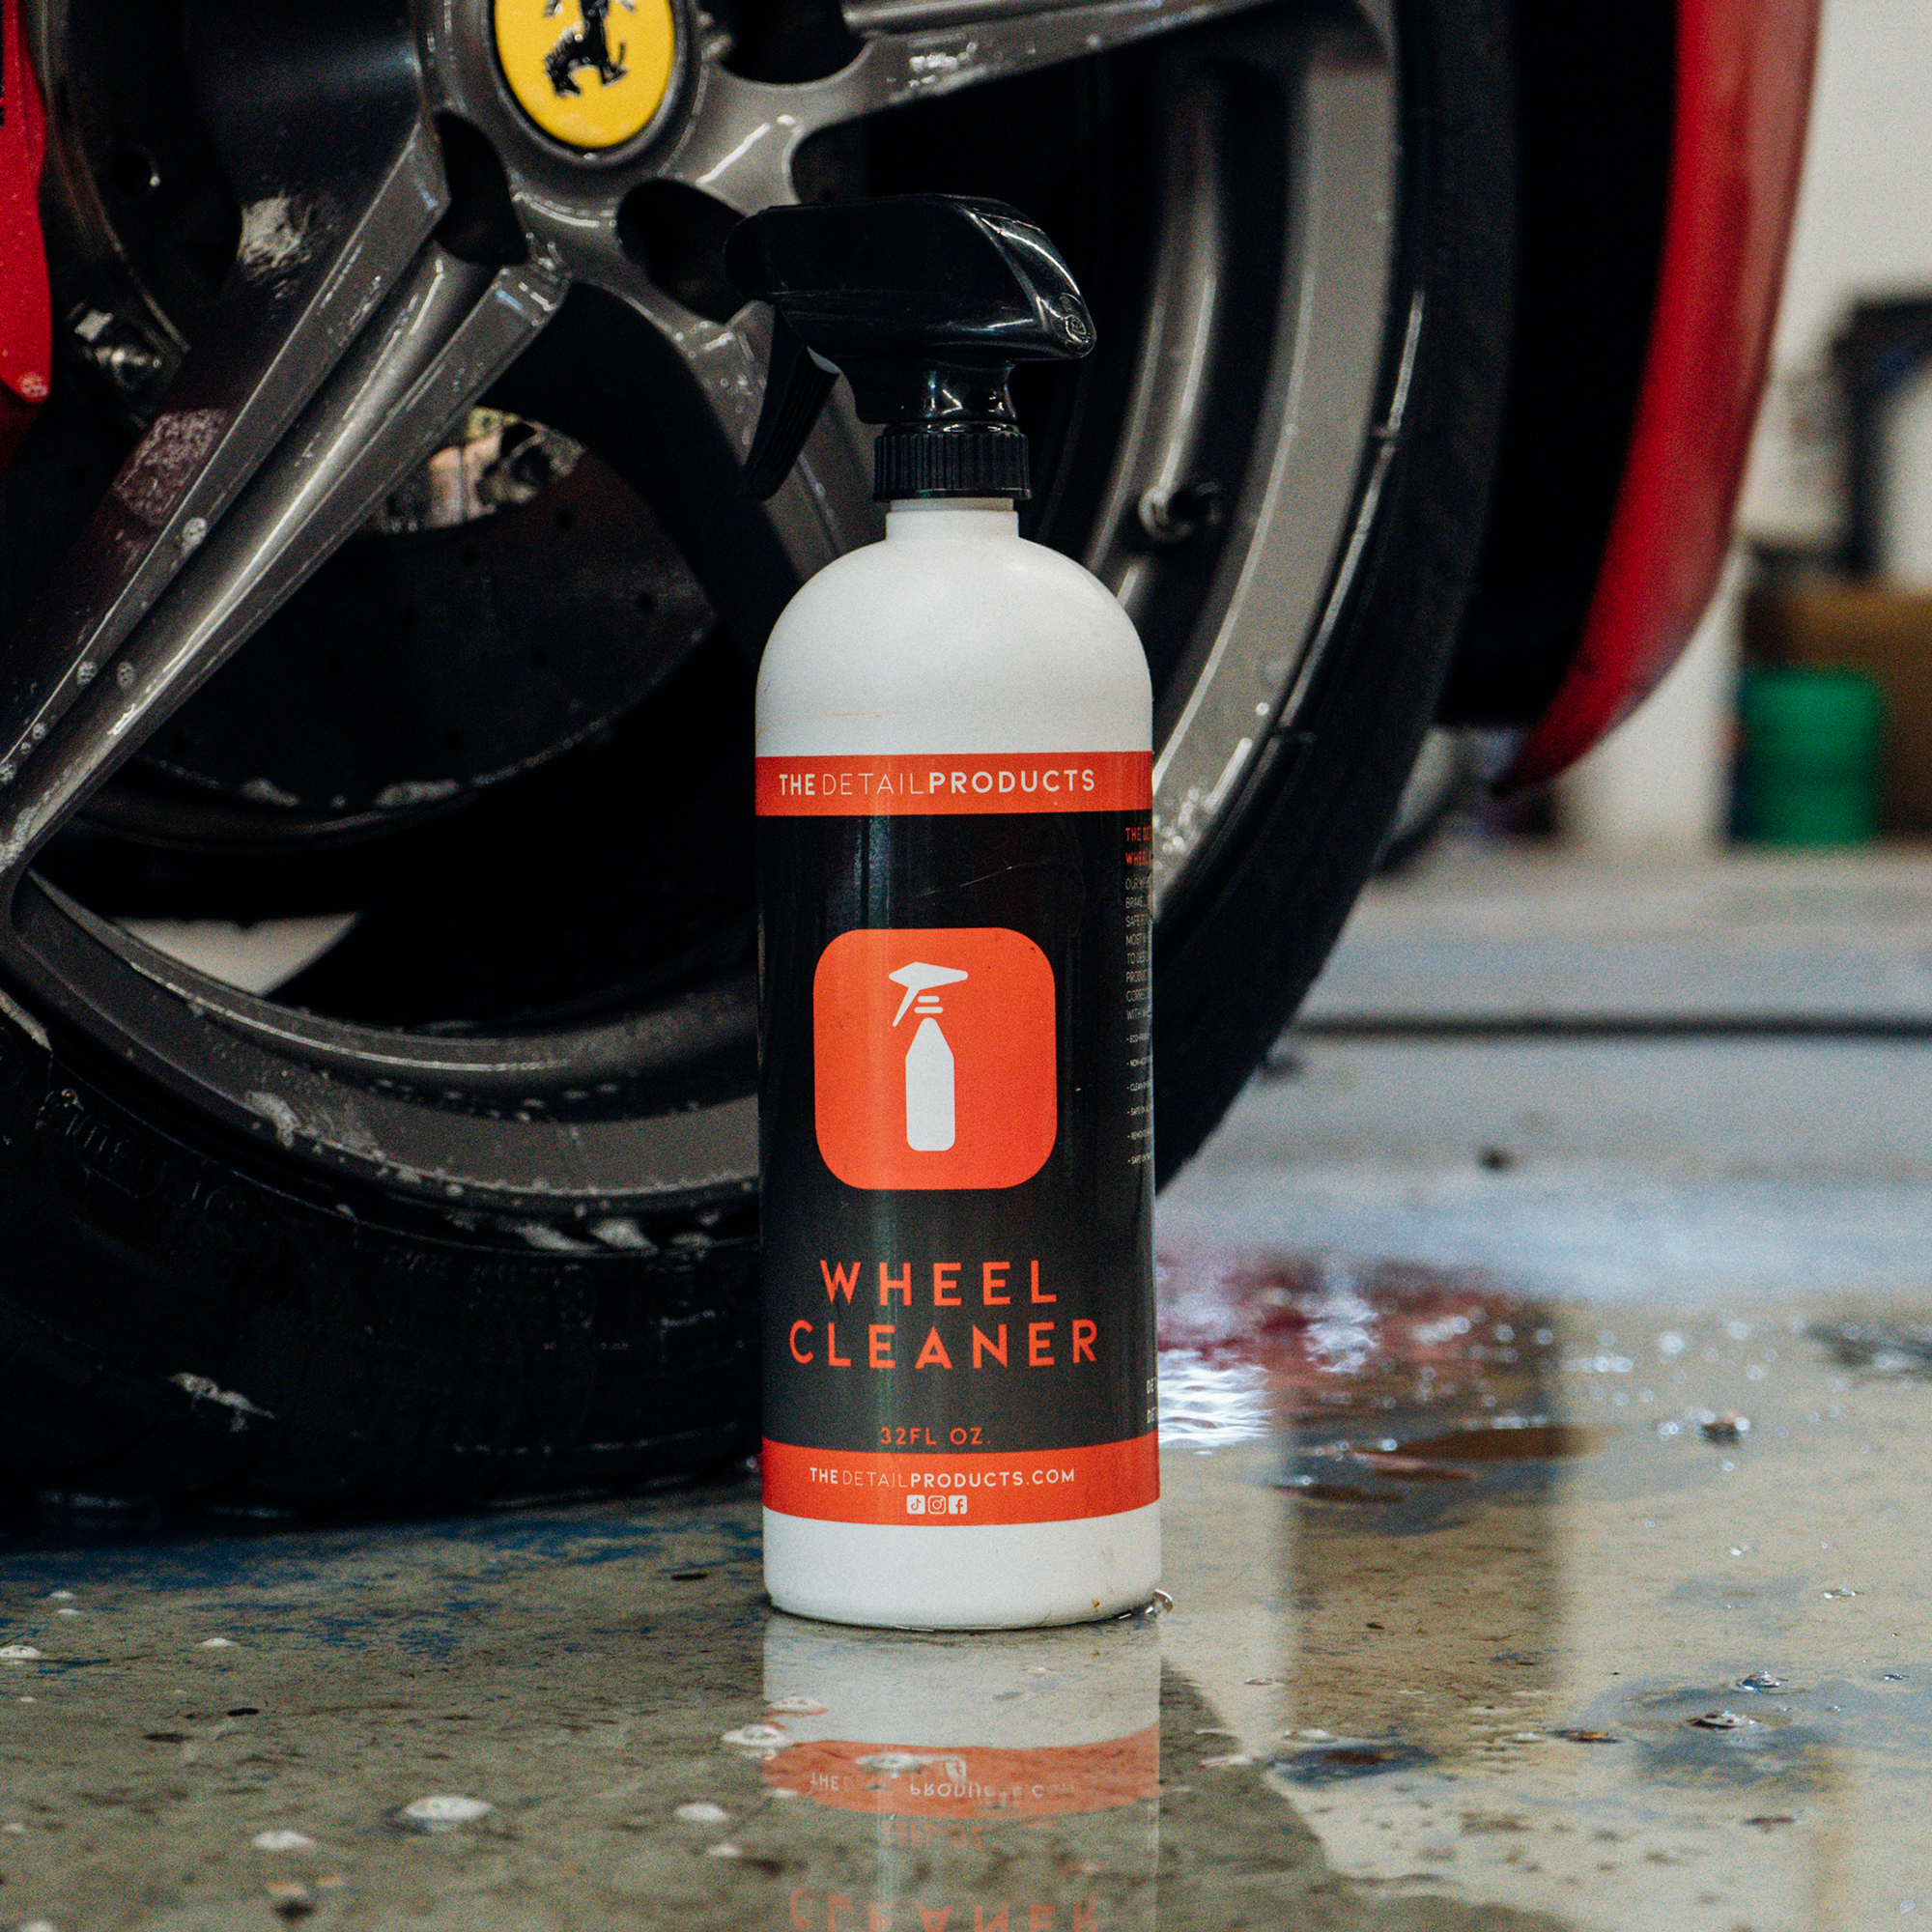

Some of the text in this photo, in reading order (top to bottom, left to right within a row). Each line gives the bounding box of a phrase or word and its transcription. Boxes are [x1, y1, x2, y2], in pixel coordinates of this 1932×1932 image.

[1124, 827, 1141, 841] THE
[819, 1259, 1057, 1307] WHEEL
[788, 1319, 1098, 1370] CLEANER
[880, 1427, 938, 1445] 32FL
